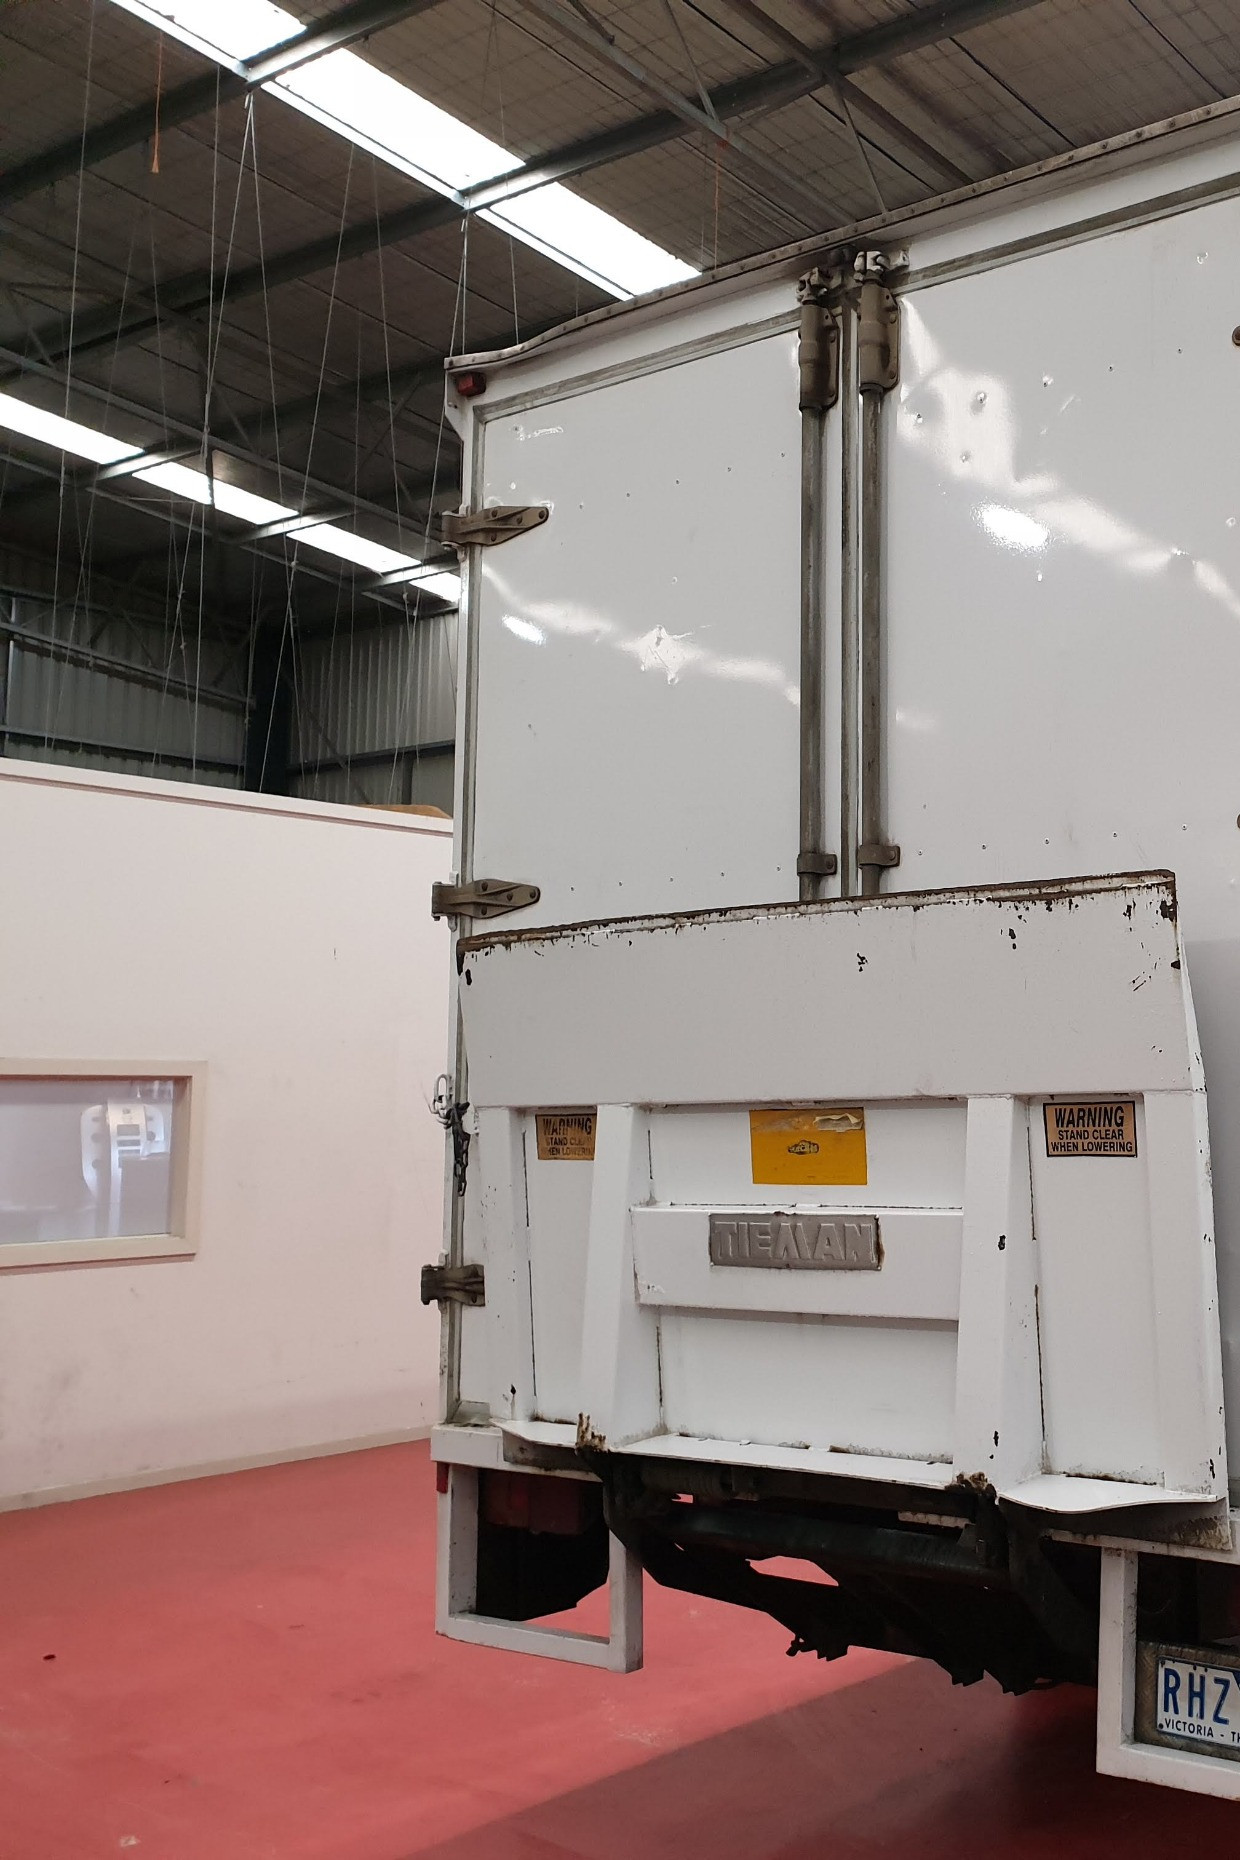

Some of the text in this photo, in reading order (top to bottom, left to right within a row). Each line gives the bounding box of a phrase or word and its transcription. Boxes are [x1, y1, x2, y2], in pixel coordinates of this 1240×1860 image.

[542, 1117, 592, 1136] WARNING
[1054, 1106, 1125, 1128] WARNING
[1058, 1129, 1124, 1140] STAND CLEAR
[1051, 1141, 1133, 1152] WHEN LOWERING
[1163, 1667, 1230, 1725] RHZ
[1164, 1718, 1214, 1738] VICTORIA
